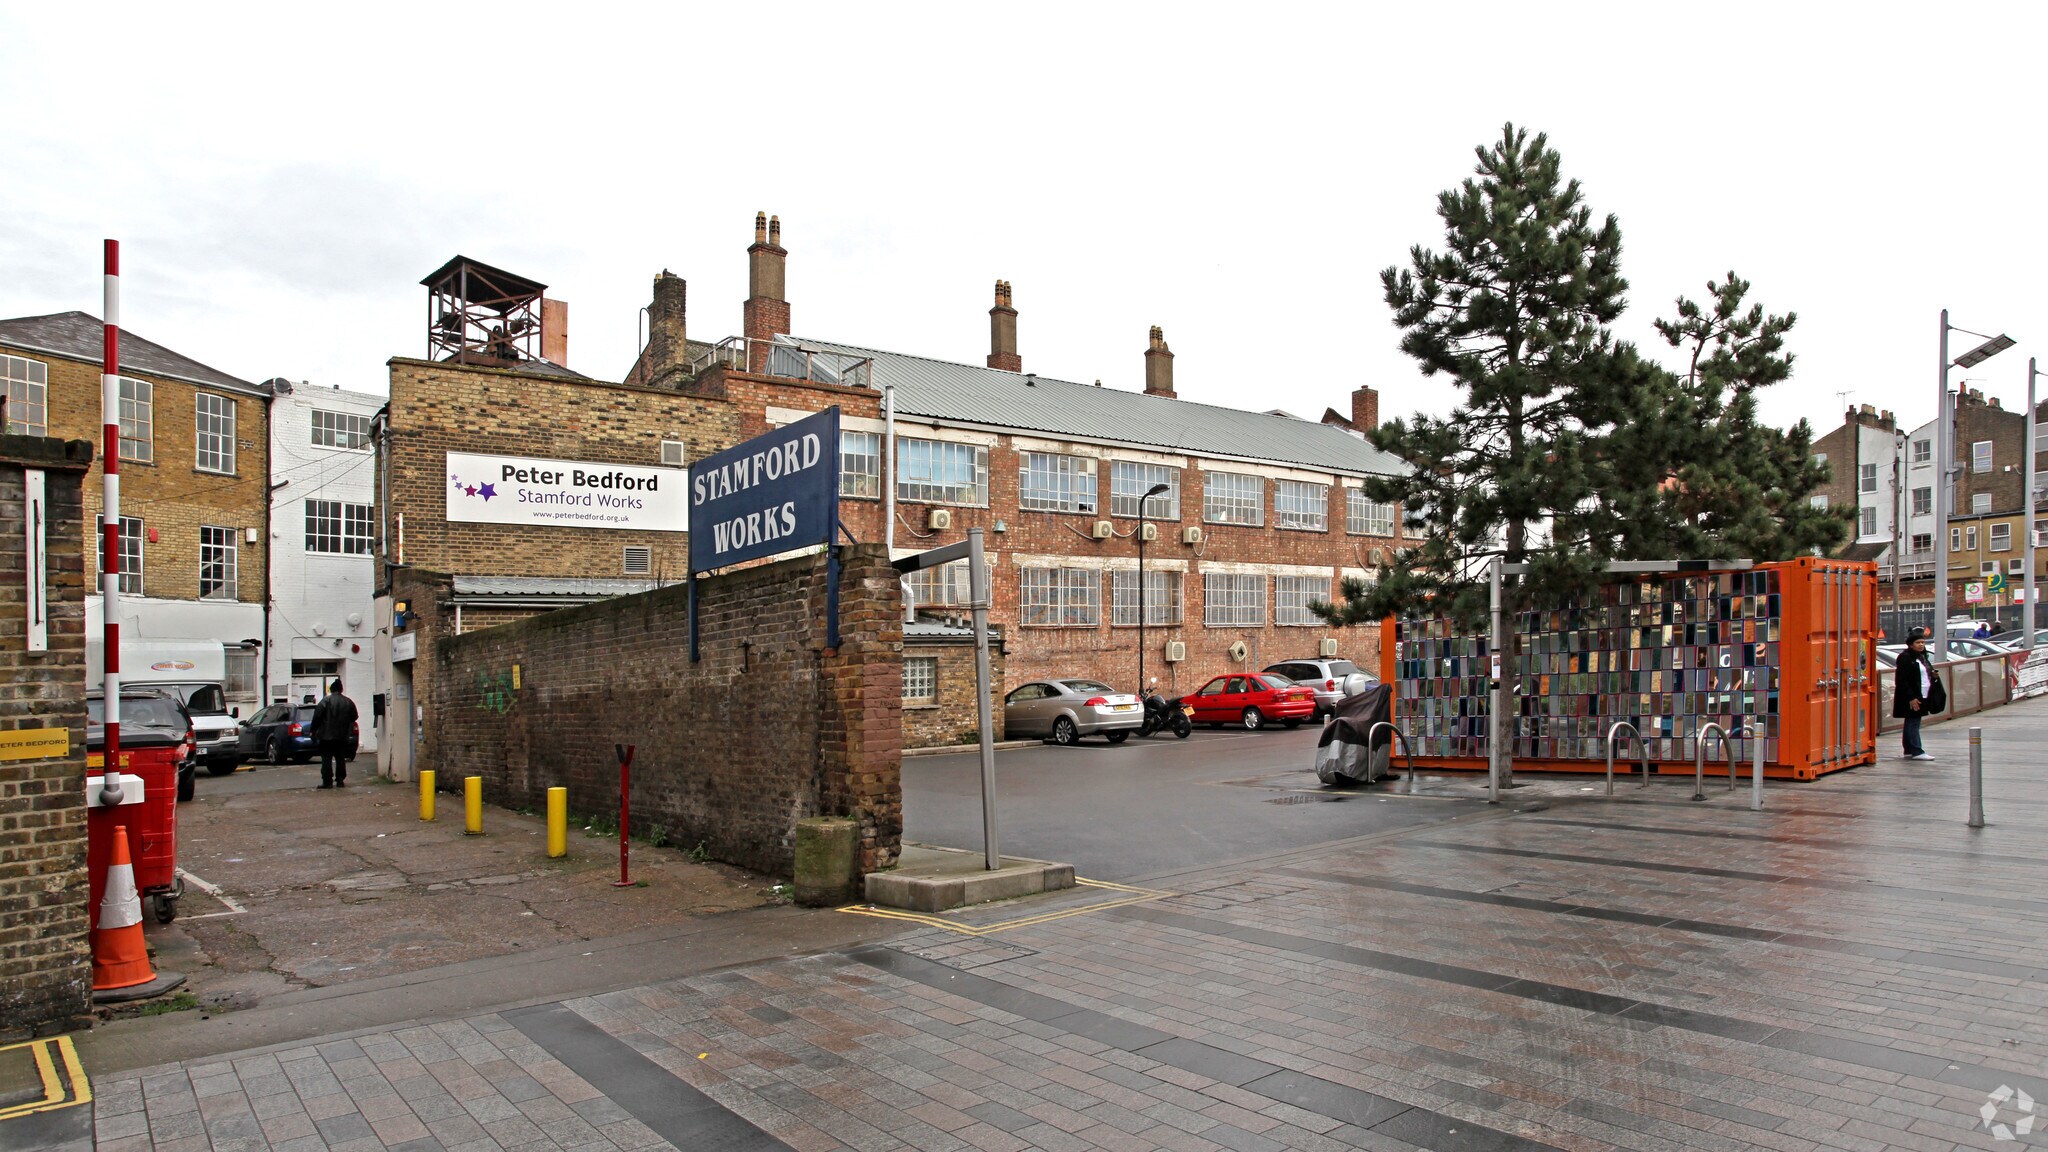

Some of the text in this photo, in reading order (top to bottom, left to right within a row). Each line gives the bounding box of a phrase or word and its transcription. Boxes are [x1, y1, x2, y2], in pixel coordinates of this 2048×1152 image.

[502, 464, 658, 491] Peter Bedford
[694, 433, 821, 506] STAMFORD
[518, 488, 643, 509] Stamford Works
[533, 510, 630, 523] www.peterbedford.org.uk
[713, 501, 796, 554] WORKS
[0, 739, 67, 749] ETER BEDFORD
